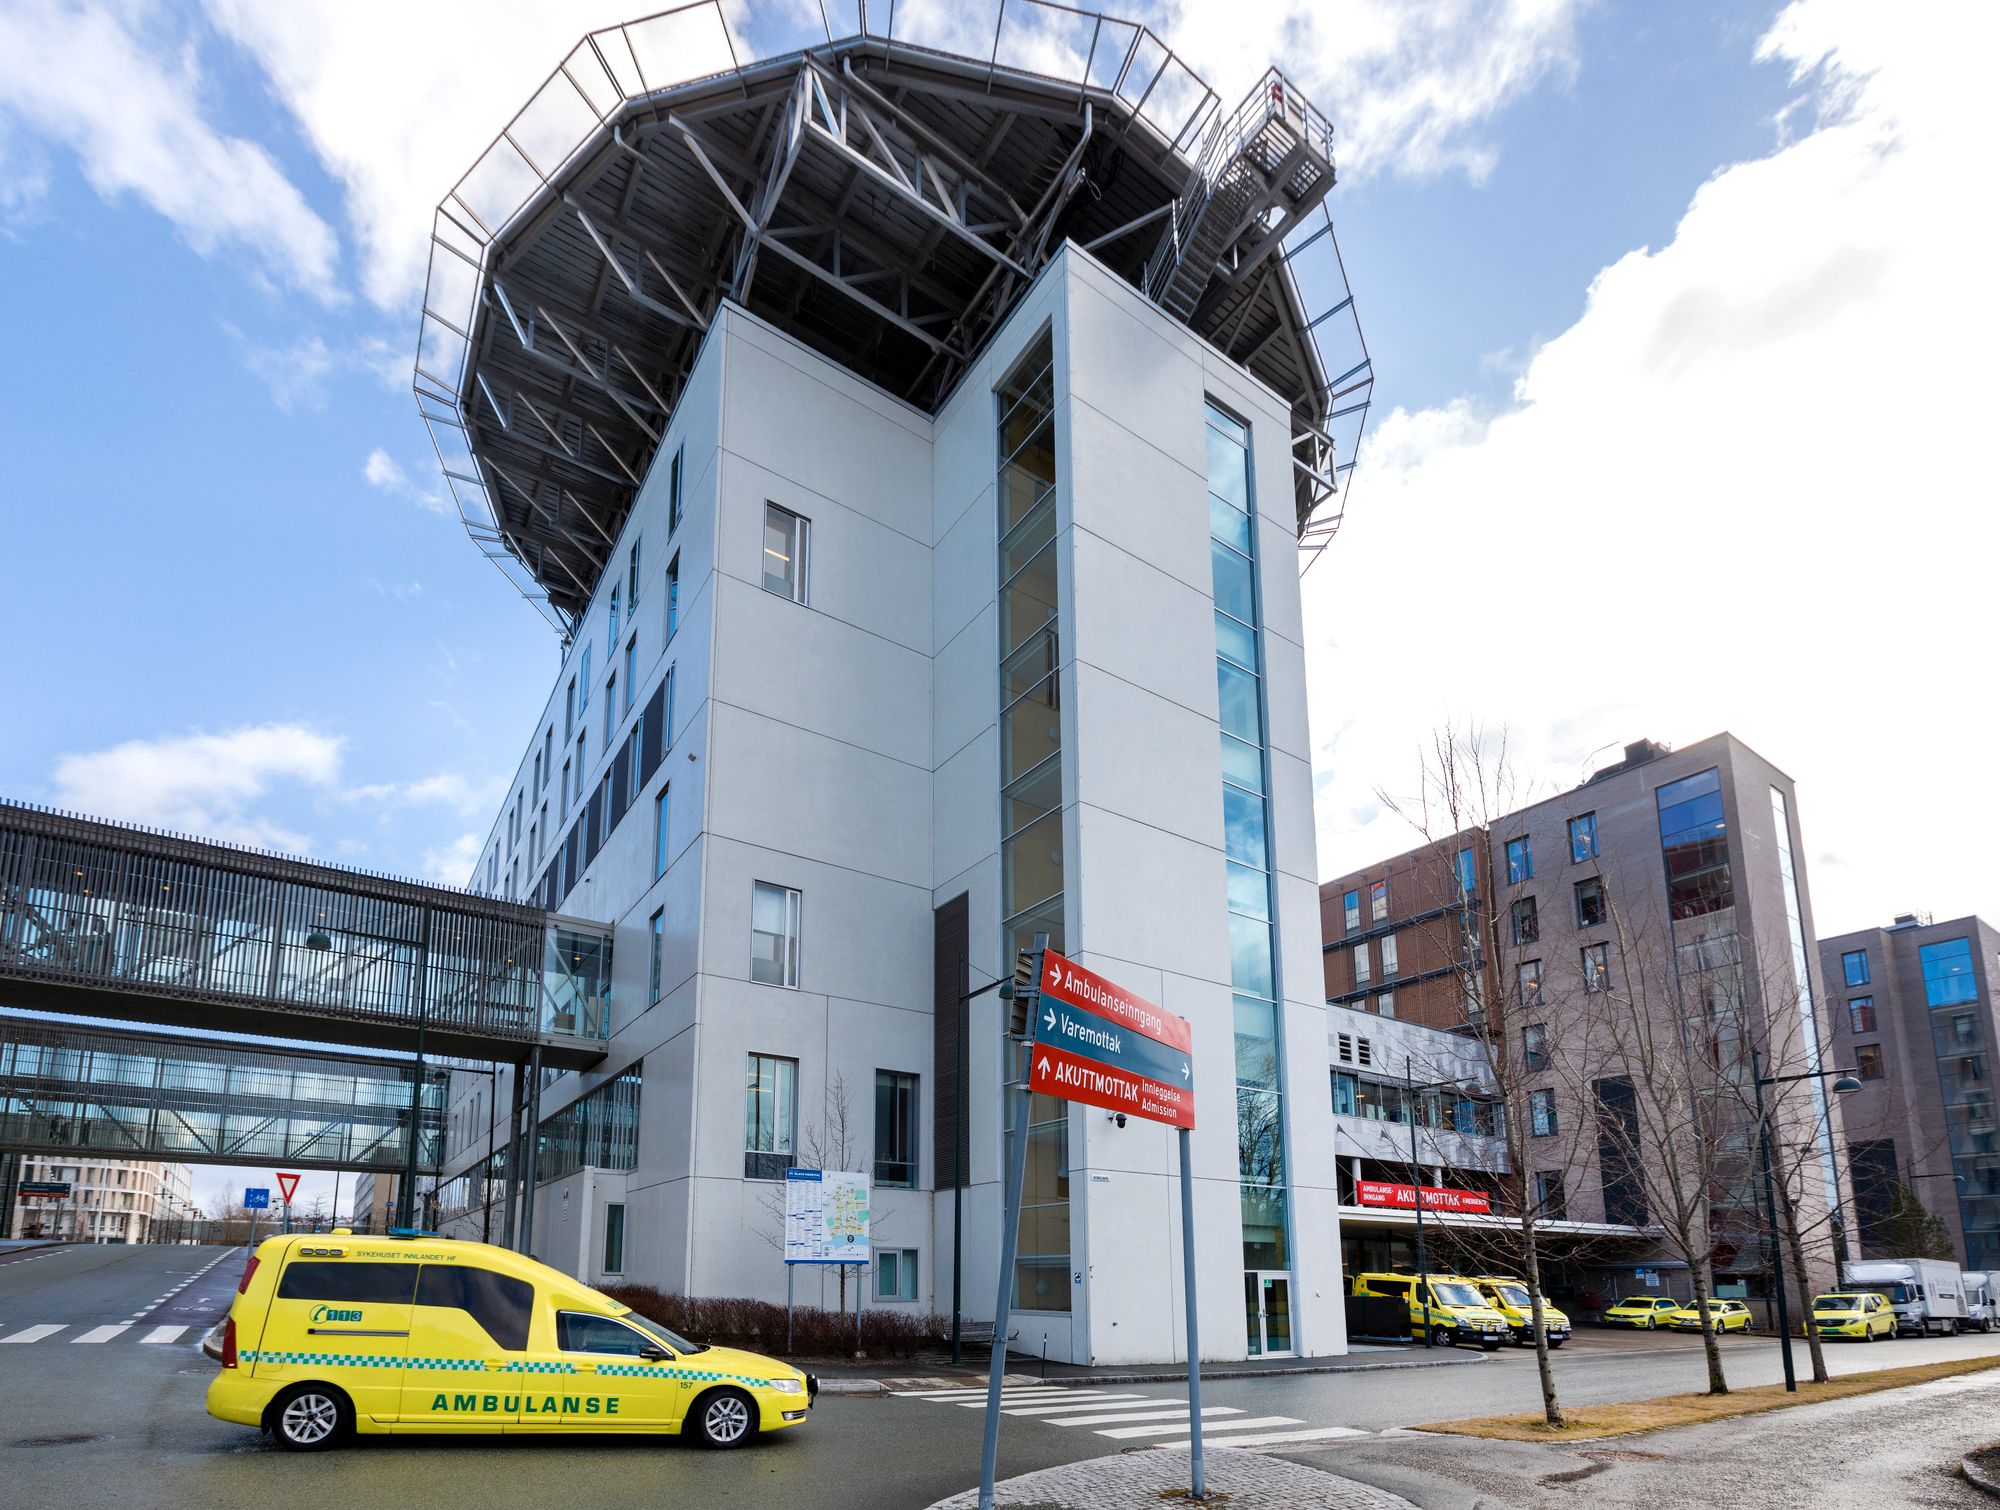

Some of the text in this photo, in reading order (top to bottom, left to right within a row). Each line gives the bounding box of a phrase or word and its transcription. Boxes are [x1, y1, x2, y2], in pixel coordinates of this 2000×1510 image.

[1064, 971, 1161, 1035] Ambulanseinngang
[1061, 1012, 1121, 1054] Varemottak
[1054, 1061, 1139, 1103] AKUTTMOTTAK
[1141, 1097, 1177, 1119] Admission
[1397, 1189, 1461, 1206] AKUTMOTTAK
[356, 1250, 401, 1259] SYKEHUSET
[403, 1253, 445, 1261] INNLANDET
[329, 1310, 361, 1321] 113
[431, 1394, 620, 1414] AMBULANSE
